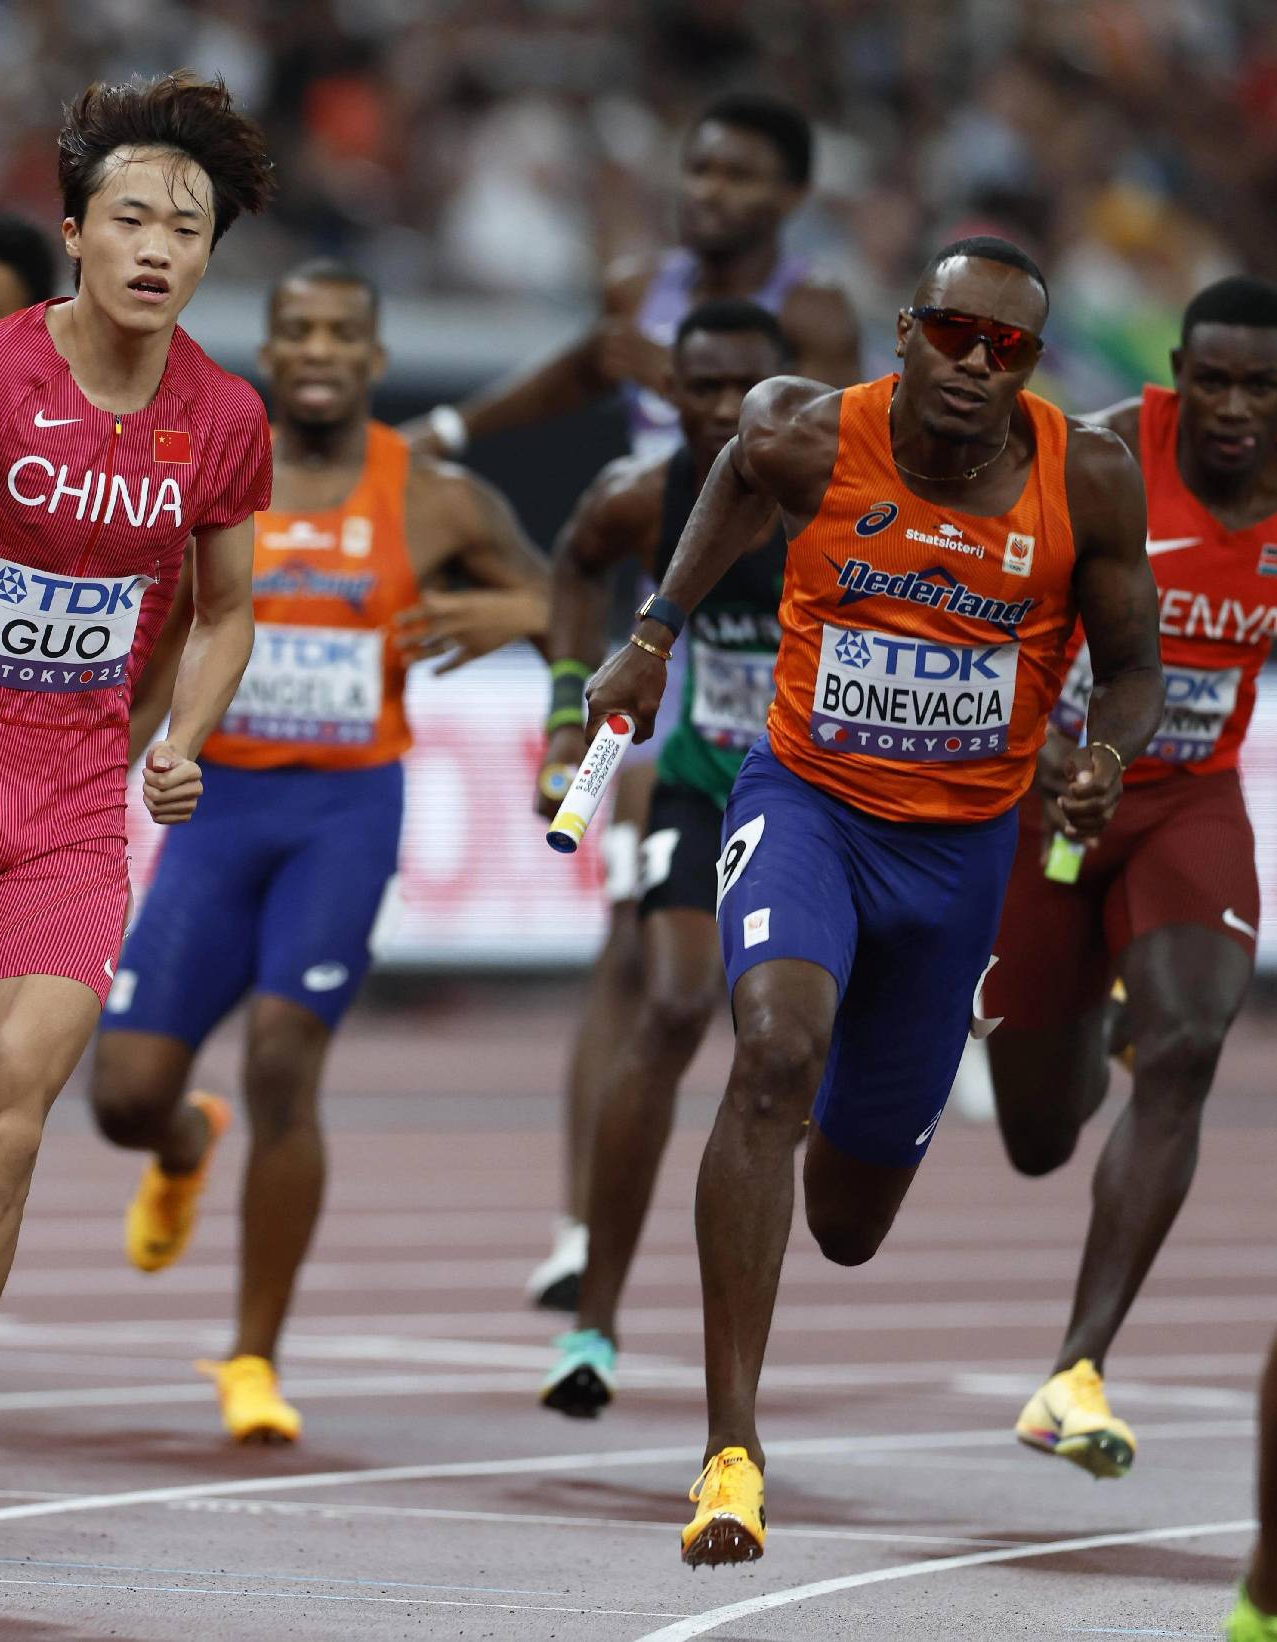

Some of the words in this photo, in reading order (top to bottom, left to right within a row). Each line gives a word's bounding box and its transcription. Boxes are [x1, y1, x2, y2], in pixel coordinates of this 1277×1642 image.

[7, 455, 182, 528] CHINA
[905, 528, 985, 559] Staatsloterij
[31, 574, 142, 616] TDK
[1158, 587, 1277, 645] ENYA
[1, 618, 111, 660] GUO
[873, 636, 1002, 682] TDK
[823, 673, 1003, 726] BONEVACIA
[1165, 672, 1231, 704] DK
[723, 839, 747, 890] 9
